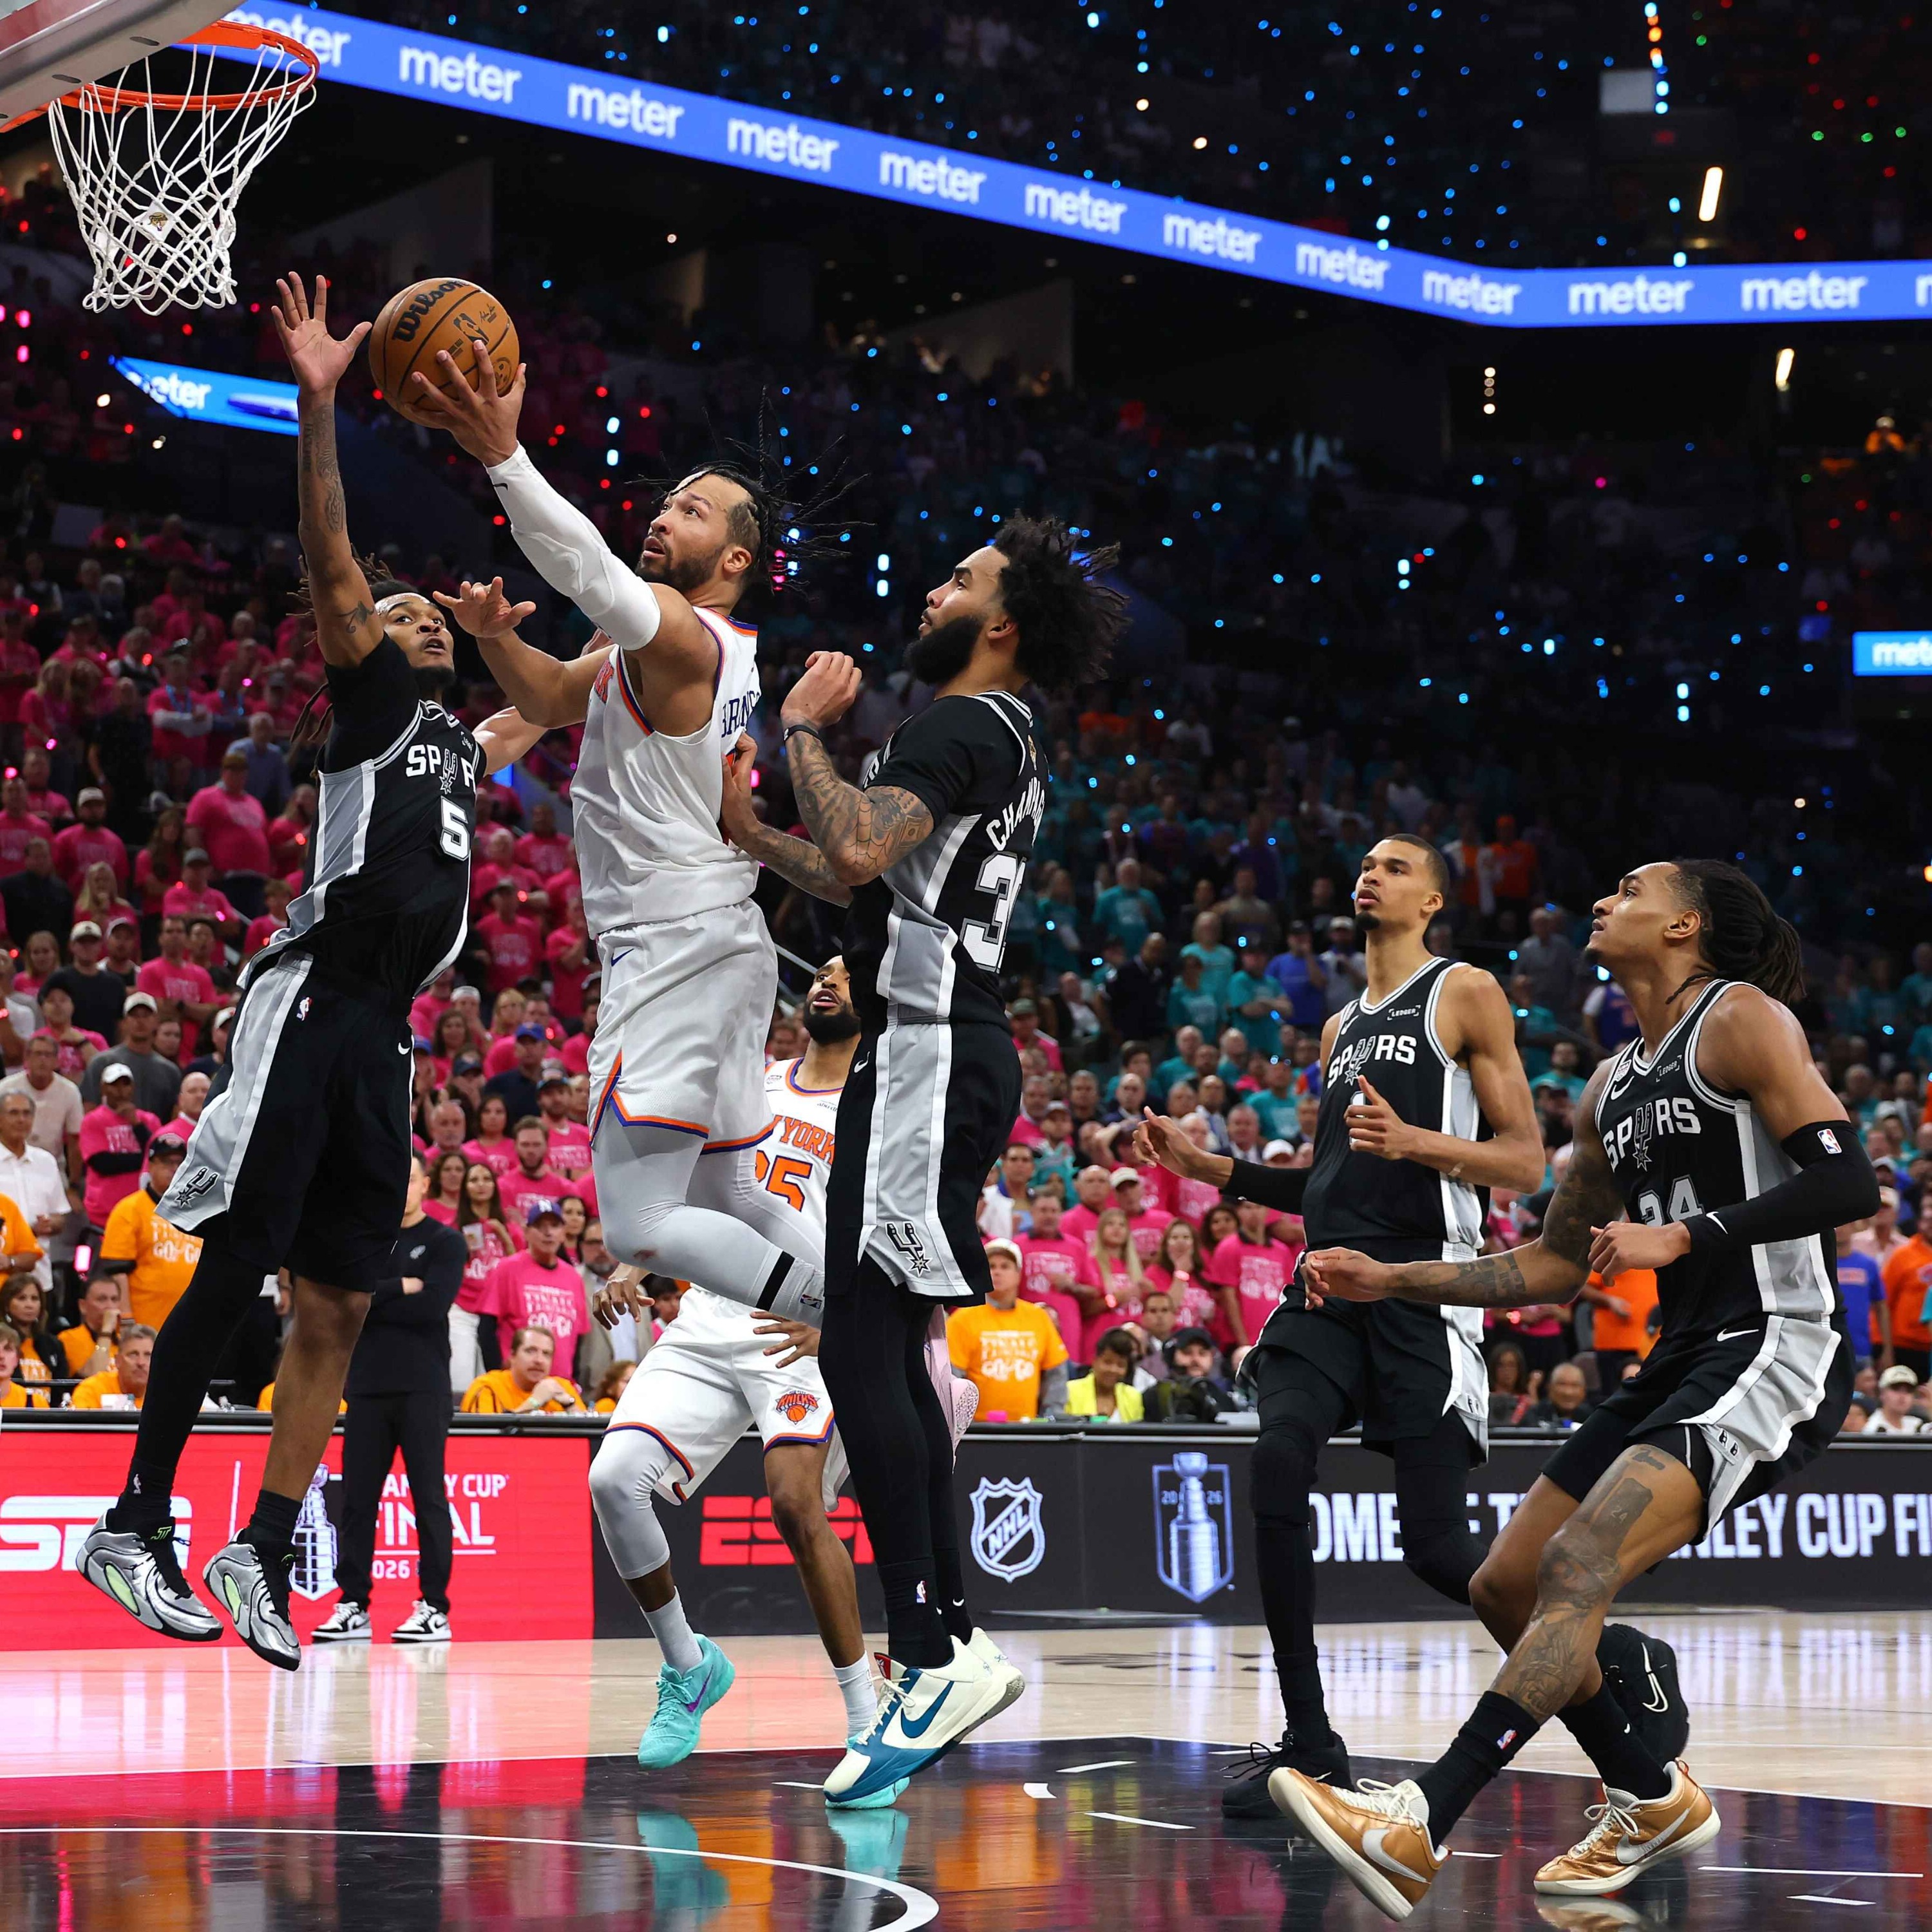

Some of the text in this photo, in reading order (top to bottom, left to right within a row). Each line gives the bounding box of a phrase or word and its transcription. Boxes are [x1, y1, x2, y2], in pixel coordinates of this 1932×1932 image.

[399, 44, 522, 104] meter
[567, 83, 684, 139] meter
[727, 118, 838, 172] meter
[880, 151, 986, 204] meter
[1025, 183, 1127, 234] meter
[1164, 214, 1262, 264] meter
[1296, 242, 1390, 290] meter
[1422, 269, 1521, 315] meter
[1741, 269, 1868, 312] meter
[1569, 274, 1694, 314] meter
[440, 795, 469, 861] 5
[959, 851, 1027, 974] 3
[1327, 1035, 1417, 1090] SPURS
[776, 1393, 819, 1413] KNICKS
[462, 1474, 507, 1497] CUP
[988, 1504, 1030, 1558] NHL
[1309, 1493, 1404, 1563] OME
[1795, 1493, 1887, 1558] CUP
[1893, 1493, 1932, 1557] FI
[372, 1560, 410, 1579] 026
